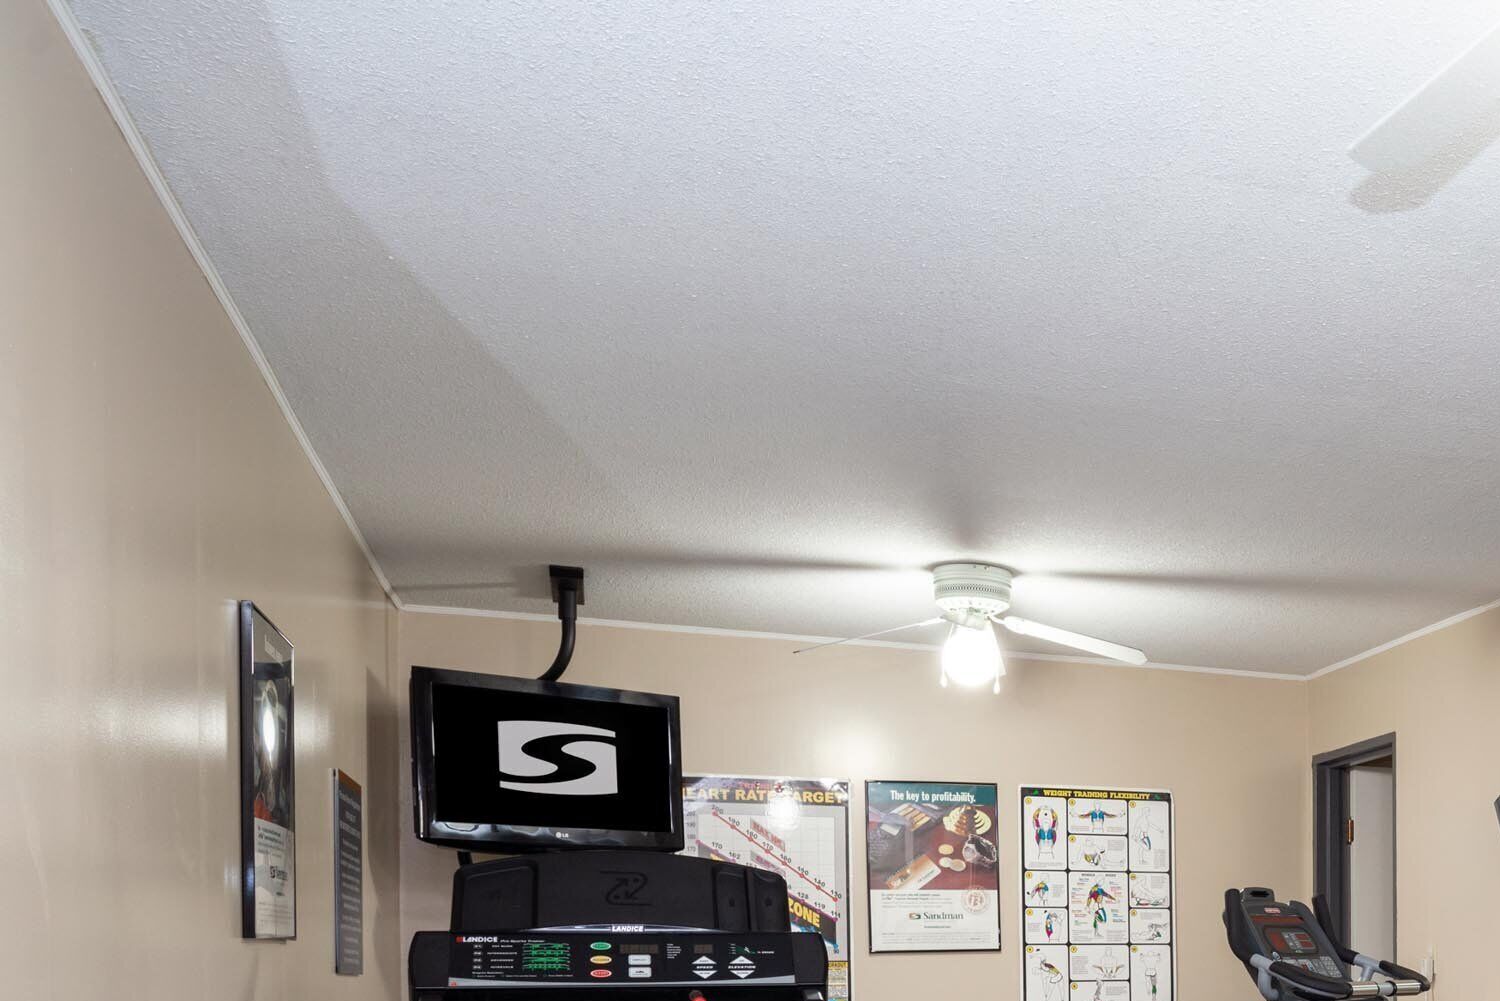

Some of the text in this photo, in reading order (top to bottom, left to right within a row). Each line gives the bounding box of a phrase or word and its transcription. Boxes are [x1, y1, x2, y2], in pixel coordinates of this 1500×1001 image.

[782, 789, 844, 804] ARGET
[890, 790, 976, 803] The key to profitability.
[1043, 789, 1150, 800] WEIGHT TRAINING FLEXIBILITY
[923, 912, 964, 920] Sandman
